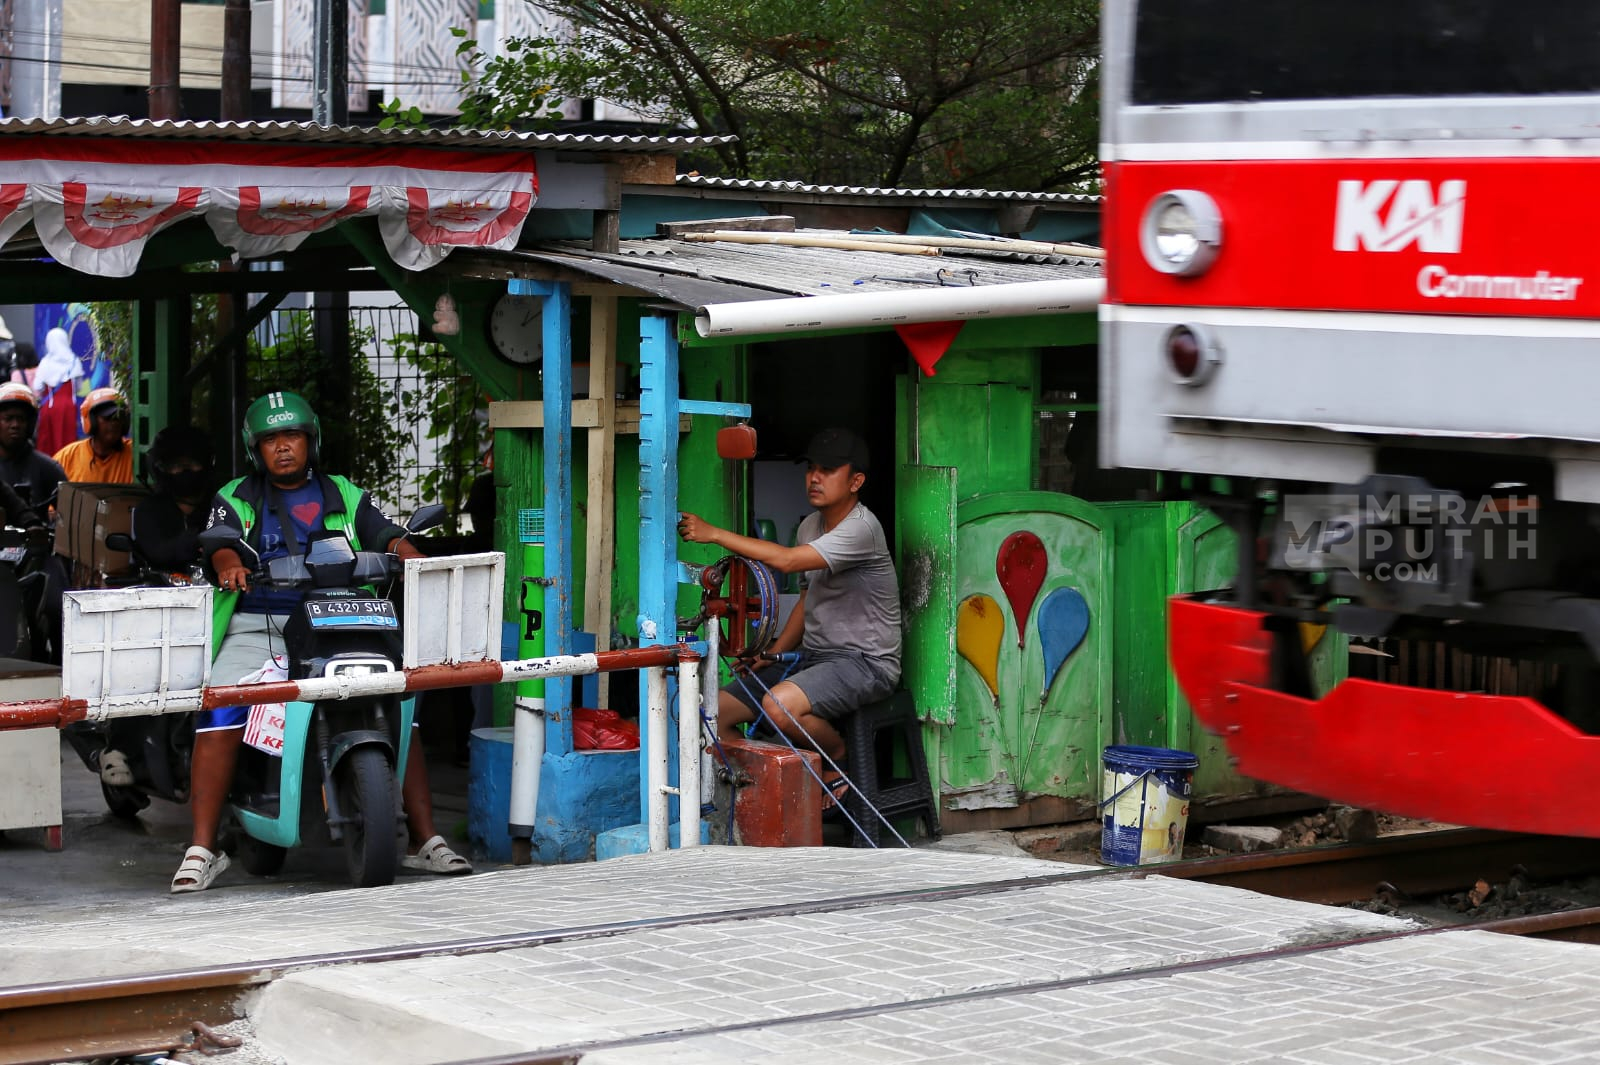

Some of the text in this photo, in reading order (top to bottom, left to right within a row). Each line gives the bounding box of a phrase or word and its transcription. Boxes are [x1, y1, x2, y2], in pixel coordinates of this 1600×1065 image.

[1332, 179, 1467, 253] KAI
[1416, 264, 1583, 301] Commuter
[266, 410, 295, 425] Grab
[312, 604, 321, 614] B
[327, 603, 360, 613] 4329
